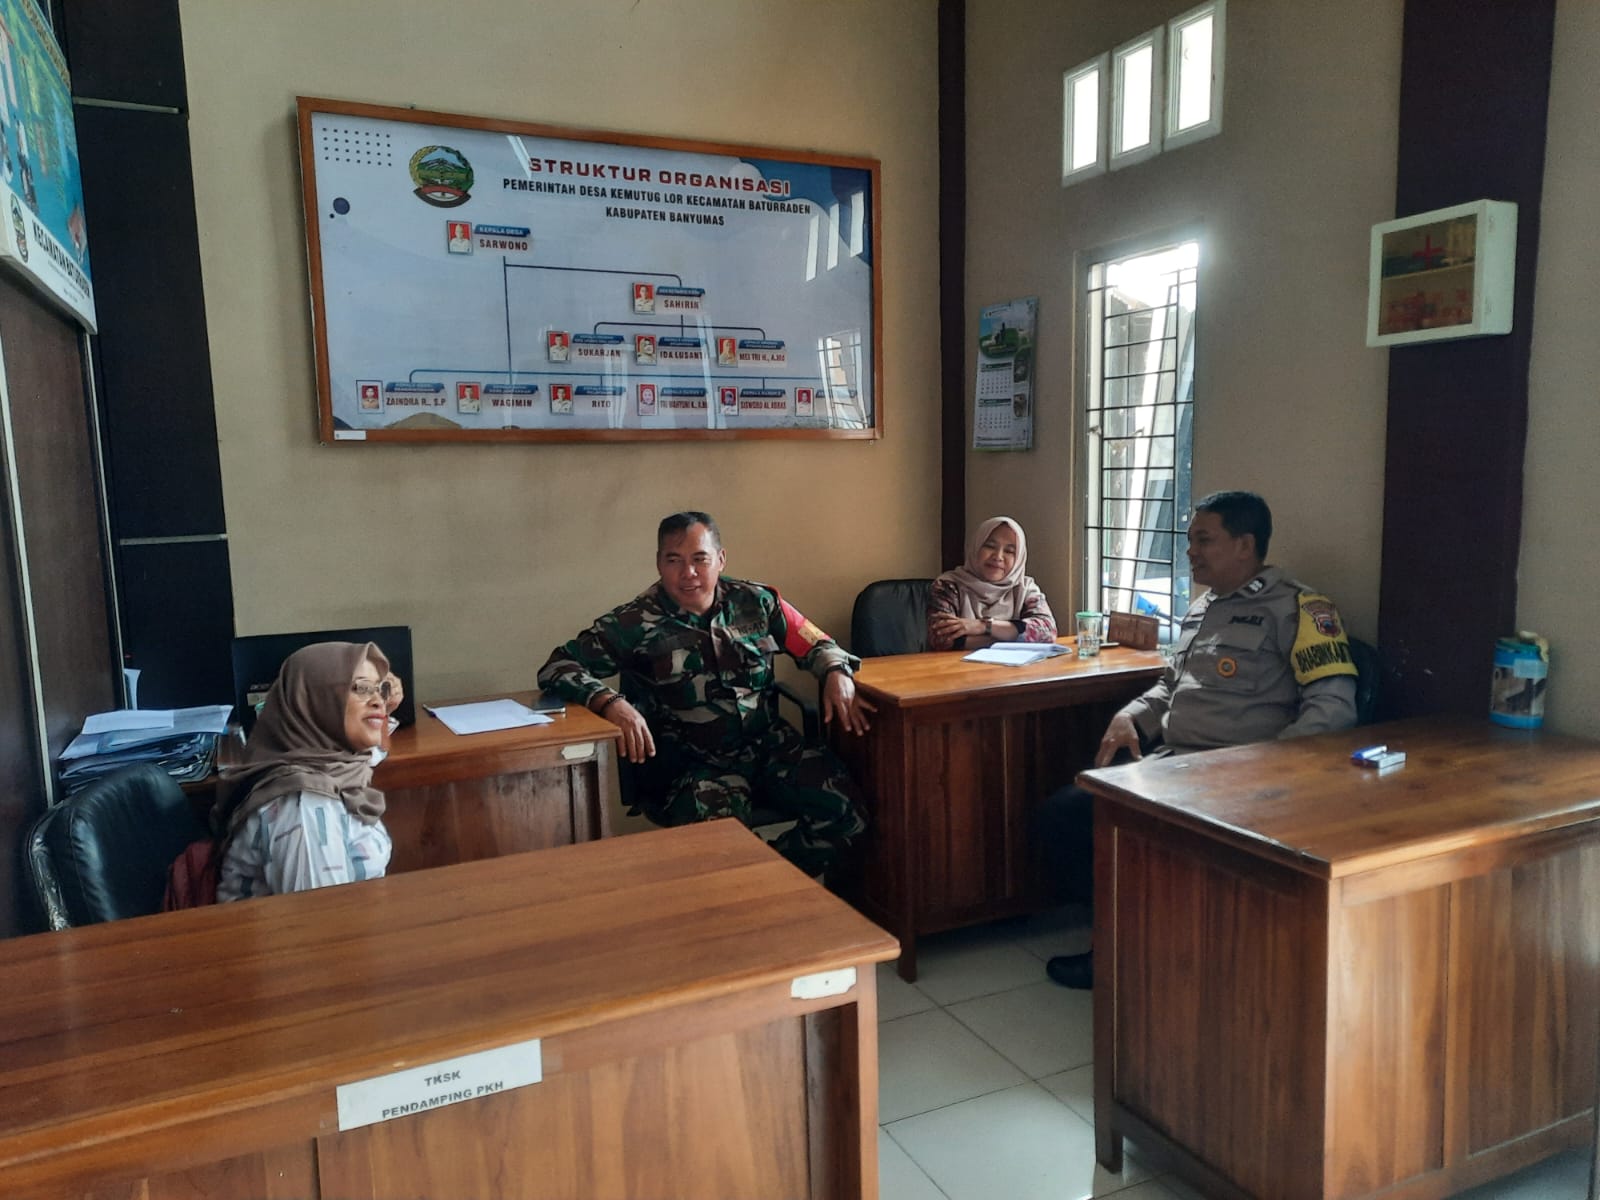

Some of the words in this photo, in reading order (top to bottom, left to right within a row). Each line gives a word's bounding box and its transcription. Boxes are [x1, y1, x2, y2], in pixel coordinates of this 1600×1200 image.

[529, 157, 651, 182] STRUKTUR
[658, 170, 791, 195] ORGANISASI
[503, 178, 576, 195] PEMERINTAH
[579, 184, 607, 198] DESA
[611, 186, 661, 203] KEMUTUG
[664, 192, 683, 205] LOR
[687, 195, 746, 210] KECAMATAN
[749, 200, 811, 214] BATURRADEN
[606, 206, 666, 222] KABUPATEN
[669, 210, 725, 226] BANYUMAS
[479, 238, 528, 251] SARWONO
[664, 299, 699, 309] SAHIRIN
[578, 347, 621, 358] SUKARJAN
[660, 351, 673, 359] IDA
[491, 399, 533, 408] WAGIMIN
[424, 1070, 461, 1087] TKSK
[382, 1088, 473, 1119] PENDAMPING
[477, 1080, 504, 1096] PKH
